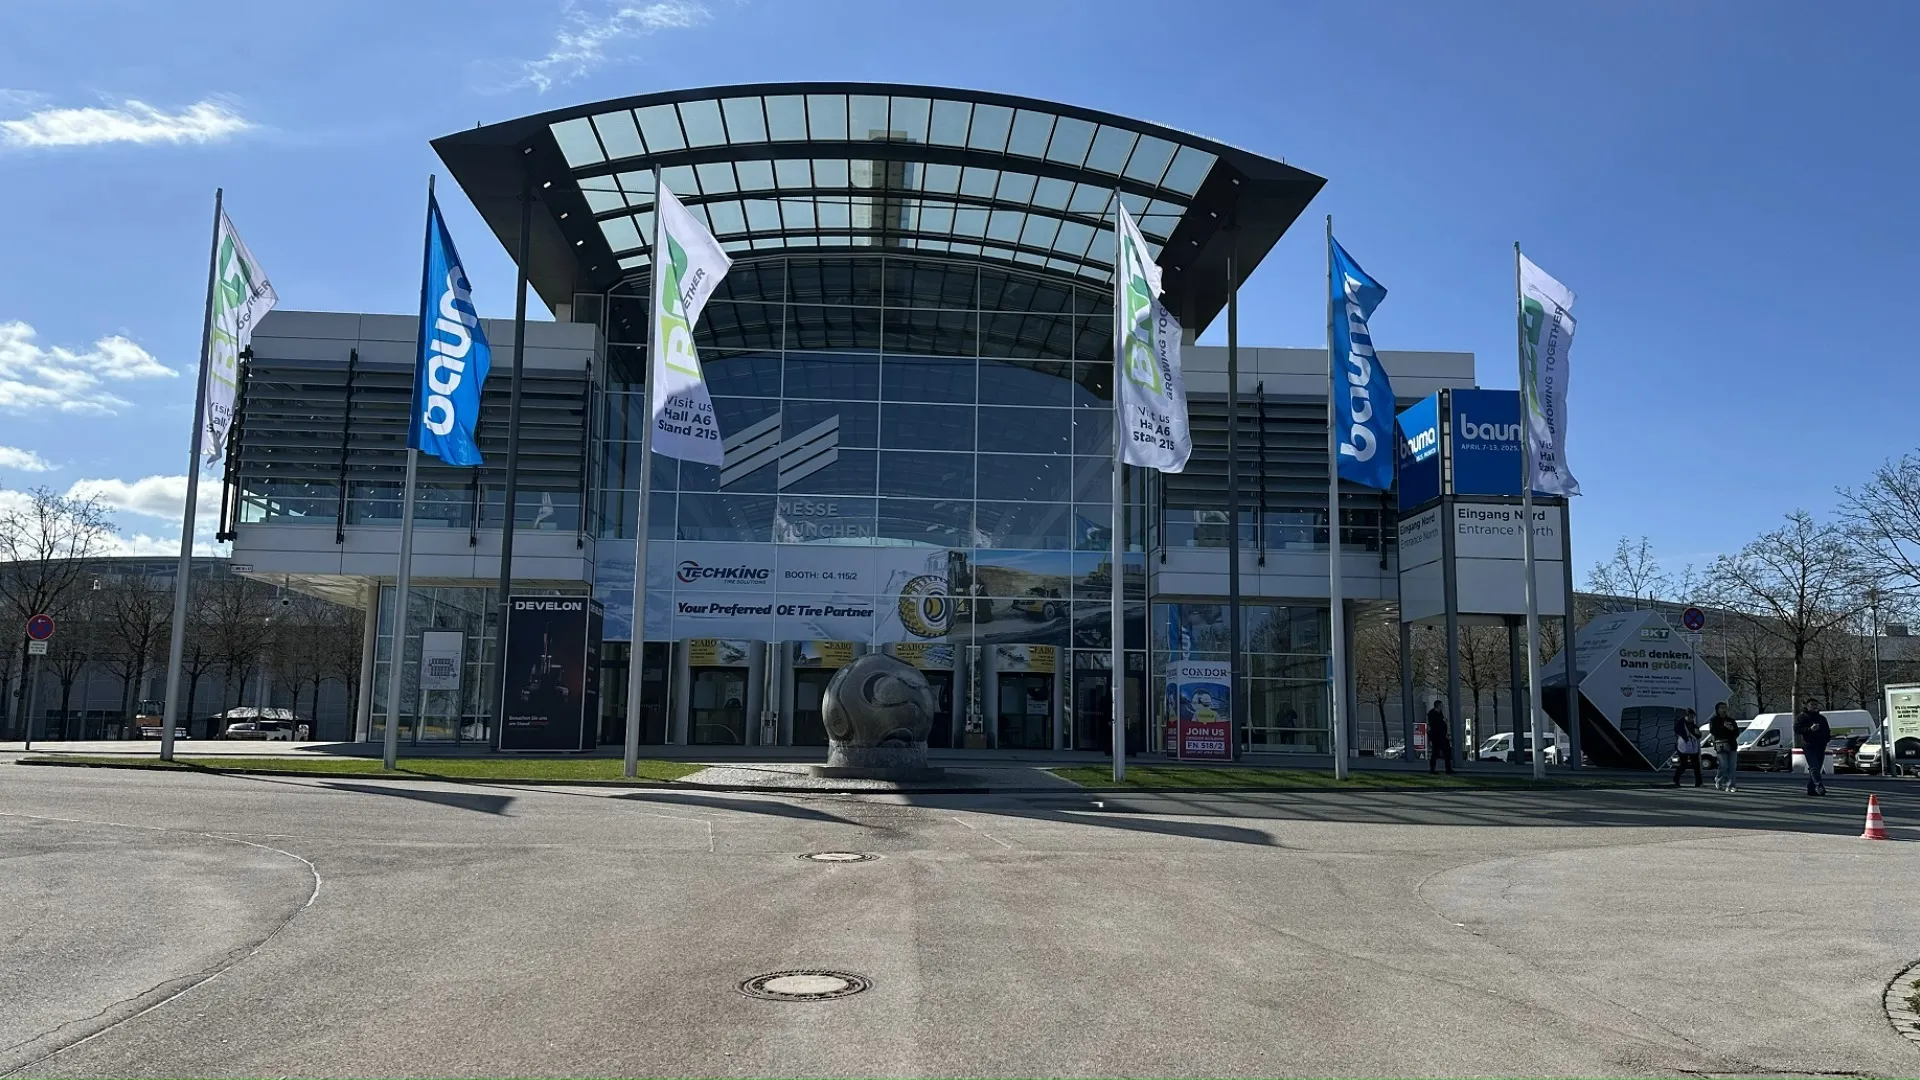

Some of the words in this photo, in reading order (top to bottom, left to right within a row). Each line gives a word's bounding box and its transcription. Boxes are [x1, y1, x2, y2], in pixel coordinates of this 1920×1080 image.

[683, 266, 706, 311] ETHER
[424, 264, 478, 436] baum
[698, 401, 713, 413] us
[664, 407, 688, 422] Hall
[692, 412, 712, 426] A6
[1159, 414, 1170, 424] us
[658, 419, 692, 437] Stand
[694, 427, 718, 441] 215
[1140, 418, 1153, 430] Ha
[1155, 424, 1170, 436] A6
[1461, 413, 1522, 441] bau
[1133, 431, 1156, 443] Stan
[1159, 438, 1174, 450] 215
[1400, 427, 1436, 459] bauma
[1540, 450, 1555, 461] Hal
[778, 502, 839, 517] MESSE
[1458, 508, 1510, 521] Eingang
[1514, 510, 1546, 521] Nrd
[778, 520, 871, 538] MÜNCHEN
[1400, 520, 1421, 535] Eingang
[1421, 512, 1436, 526] Nord
[1458, 523, 1514, 536] Entrance
[1400, 533, 1423, 549] Entrance
[1422, 528, 1439, 541] North
[784, 570, 819, 579] BOOTH:
[837, 572, 858, 580] 115/2
[515, 601, 582, 611] DEVELON
[678, 602, 708, 614] Your
[709, 603, 772, 616] Preferred
[776, 604, 795, 616] OE
[797, 604, 822, 617] Tire
[823, 605, 874, 617] Partner
[1640, 628, 1669, 638] BKT
[1619, 648, 1646, 658] Groß
[1648, 648, 1692, 660] denken.
[1182, 667, 1228, 677] CONDOR
[1620, 659, 1649, 669] Dann
[1650, 660, 1692, 671] größer.
[1186, 727, 1209, 736] JOIN
[1211, 728, 1225, 737] US
[1187, 741, 1199, 749] FN
[1200, 742, 1223, 750] 518/2
